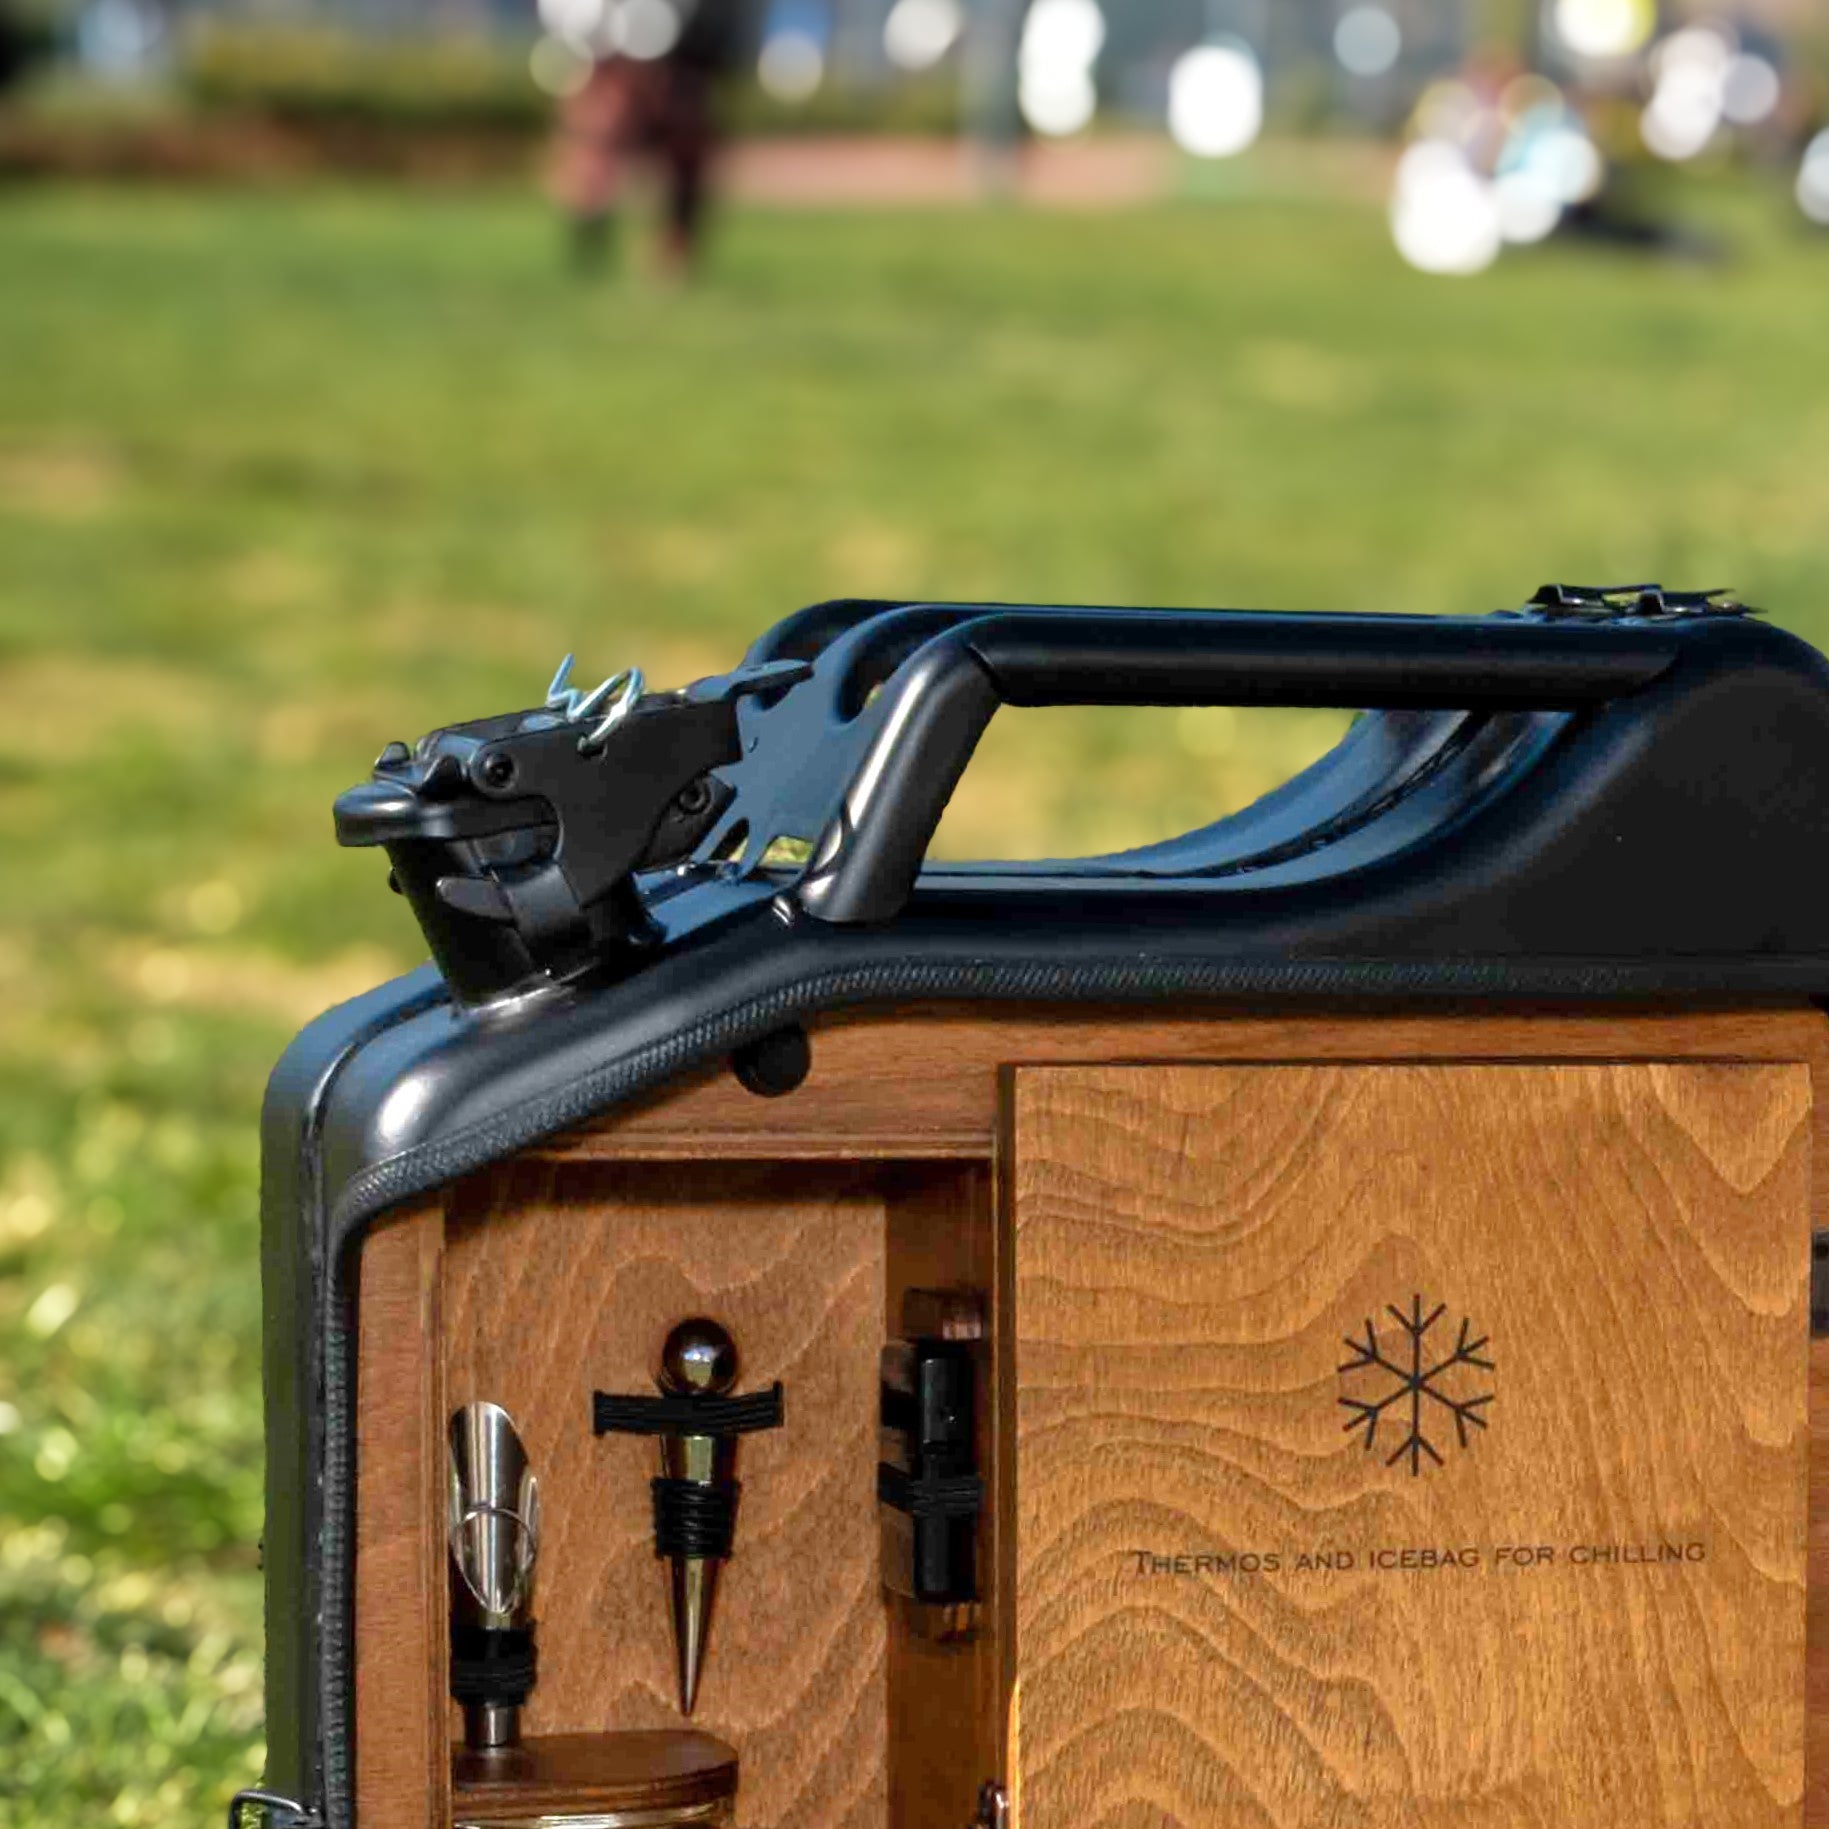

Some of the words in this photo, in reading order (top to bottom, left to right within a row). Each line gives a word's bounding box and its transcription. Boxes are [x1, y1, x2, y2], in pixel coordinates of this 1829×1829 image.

[1135, 1549, 1281, 1576] THERMOS
[1294, 1550, 1355, 1572] AND
[1369, 1547, 1480, 1569] ICEBAG
[1496, 1545, 1554, 1567] FOR
[1570, 1541, 1706, 1565] CHILLING
